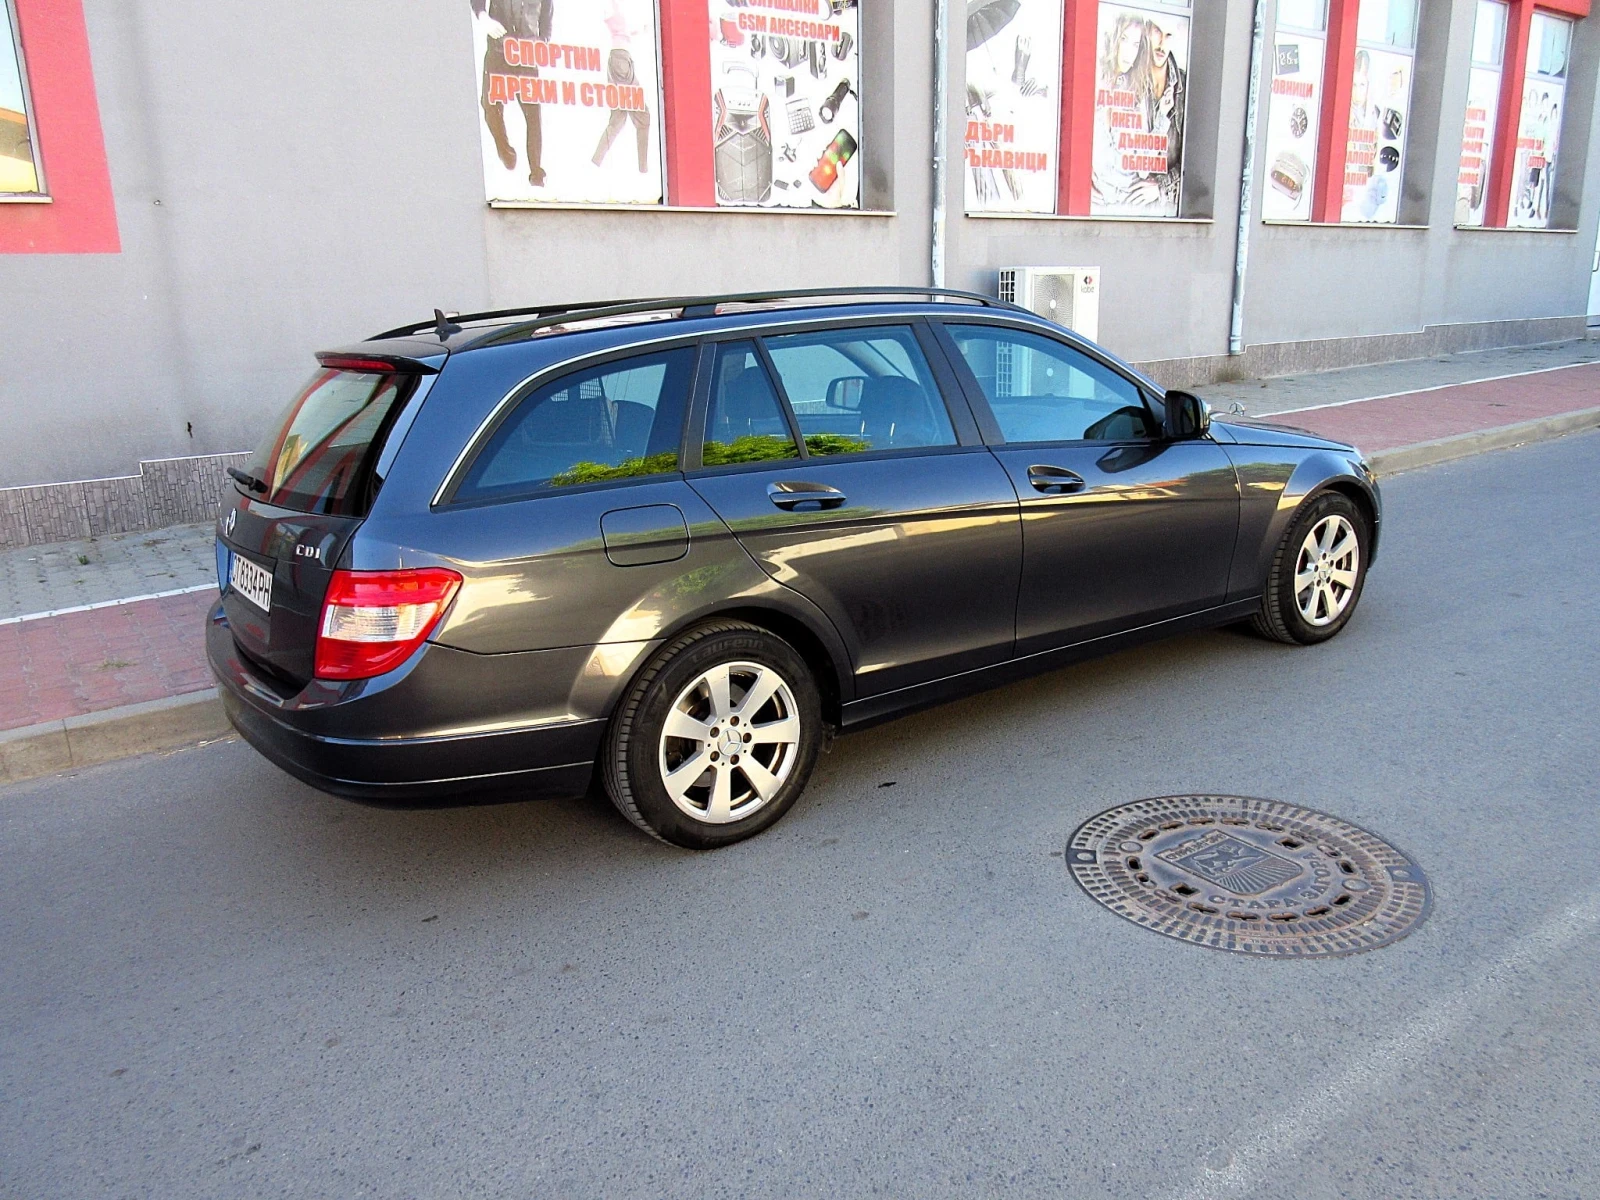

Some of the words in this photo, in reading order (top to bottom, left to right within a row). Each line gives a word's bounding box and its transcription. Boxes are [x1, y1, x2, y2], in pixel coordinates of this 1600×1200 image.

[738, 12, 767, 33] GSM
[769, 17, 840, 42] АКСЕСОАРИ
[504, 38, 601, 71] СПОРТНИ
[489, 75, 558, 105] ДРЕХИ
[562, 81, 576, 105] И
[580, 82, 645, 110] СТОКИ
[1096, 89, 1134, 108] ДЪНКИ
[1111, 111, 1143, 130] ЯКЕТА
[1118, 132, 1168, 151] ДЪНКОВИ
[1122, 154, 1168, 173] ОБЛЕКЛА
[296, 544, 321, 559] CDI
